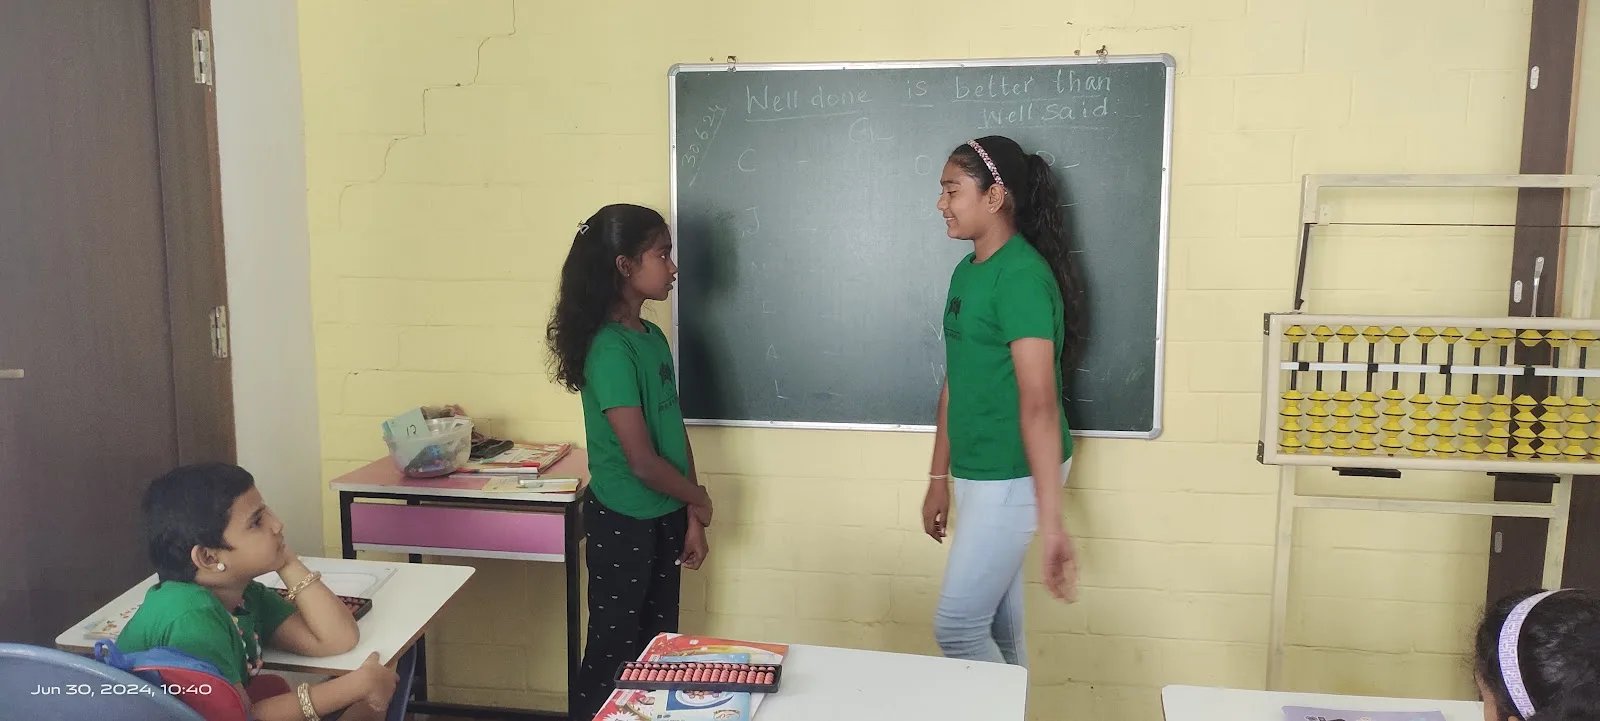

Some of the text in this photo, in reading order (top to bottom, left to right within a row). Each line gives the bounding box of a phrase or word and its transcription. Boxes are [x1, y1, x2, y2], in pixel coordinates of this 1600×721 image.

[746, 69, 1111, 114] Well done is better than
